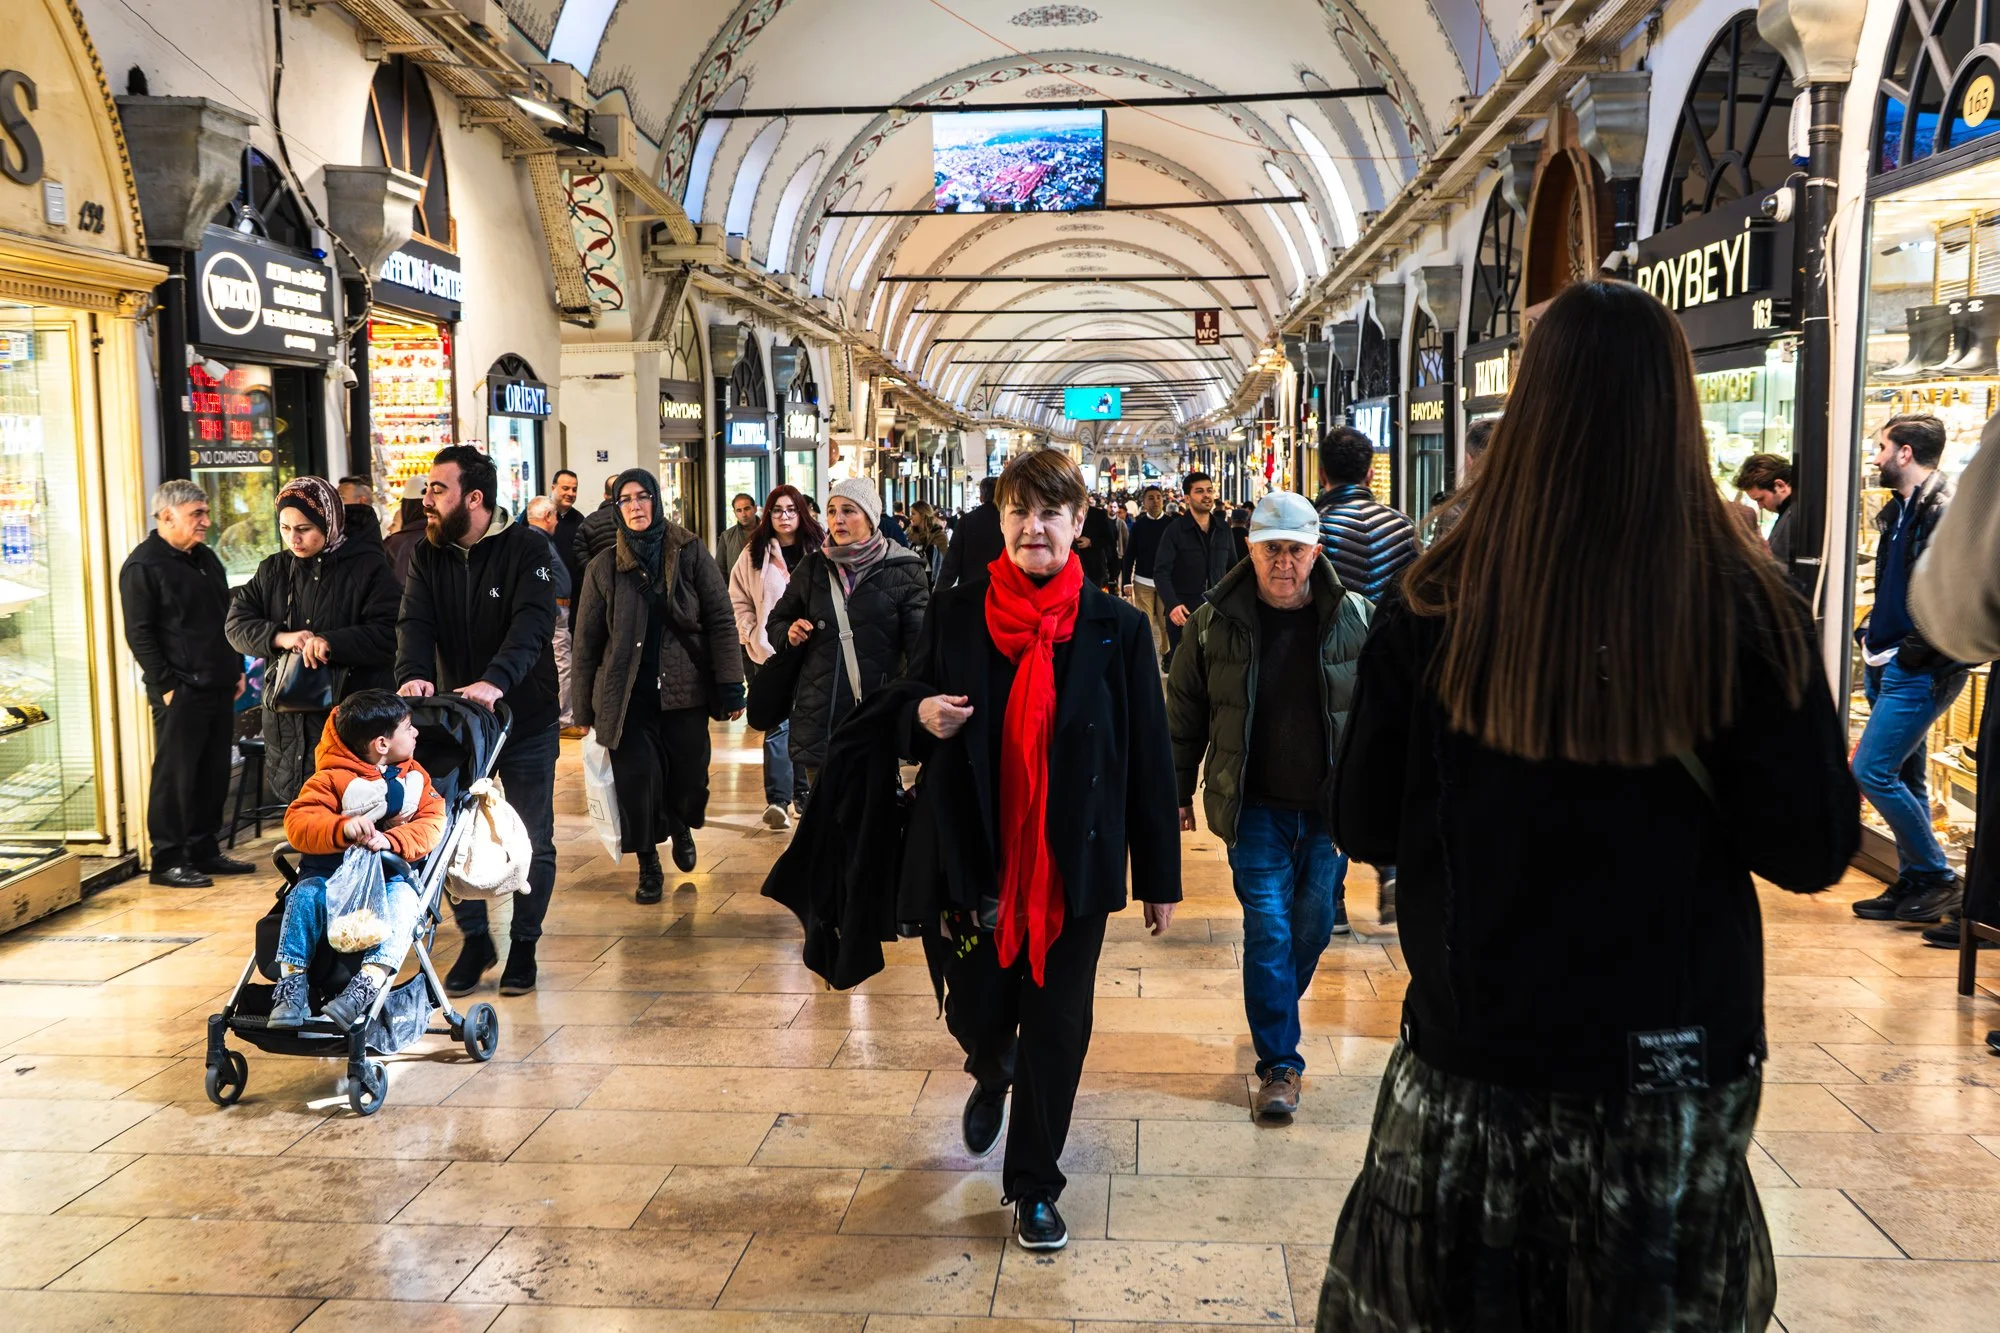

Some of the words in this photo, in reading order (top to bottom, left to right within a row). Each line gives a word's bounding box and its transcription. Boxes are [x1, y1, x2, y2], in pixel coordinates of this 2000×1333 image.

[1968, 88, 1989, 116] 165
[429, 263, 465, 303] CENTE
[1752, 298, 1773, 329] 163
[1197, 328, 1218, 338] WC
[1475, 348, 1509, 396] HAYRİ
[505, 380, 545, 415] ORİENT
[664, 401, 701, 419] HAYDAR
[200, 451, 212, 464] NO
[213, 450, 259, 464] COMMISSION
